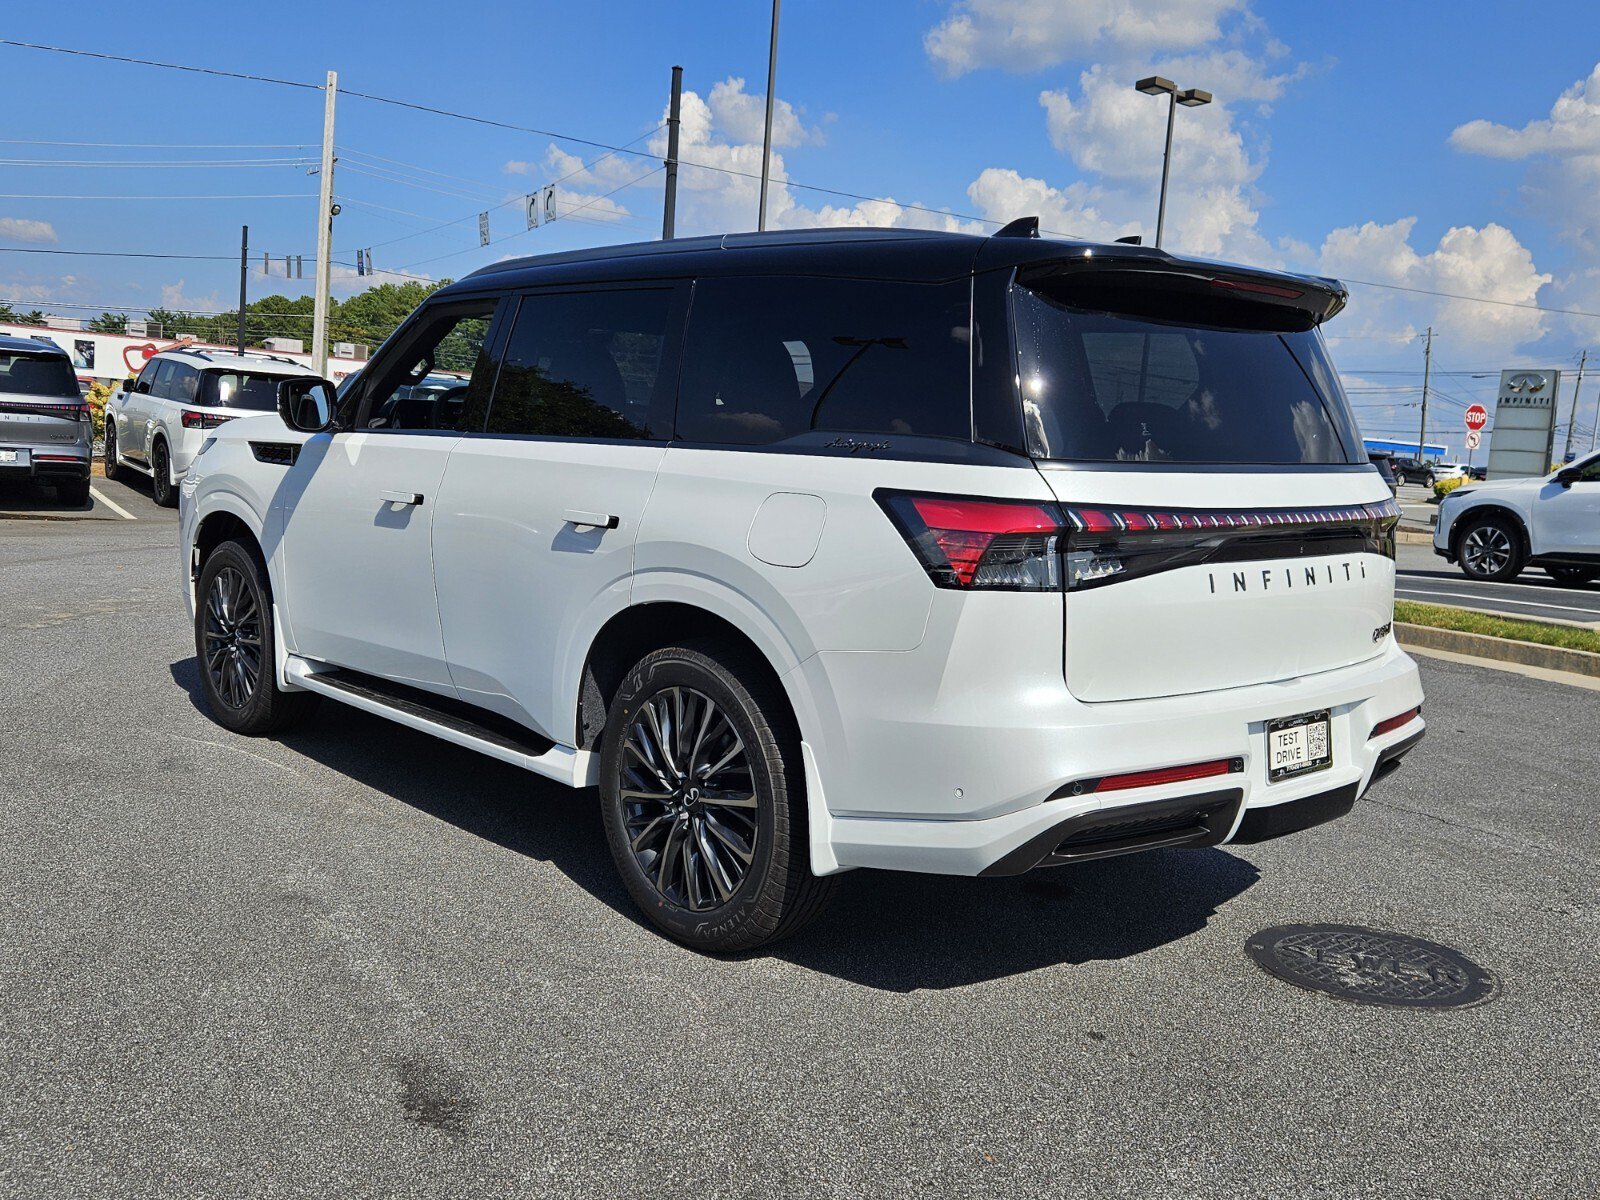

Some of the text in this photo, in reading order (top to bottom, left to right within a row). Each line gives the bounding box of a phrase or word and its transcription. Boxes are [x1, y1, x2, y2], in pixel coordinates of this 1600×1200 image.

[1466, 411, 1486, 423] STOP
[1278, 731, 1299, 747] TEST
[1276, 747, 1302, 764] DRIVE
[703, 905, 746, 939] ALENZA
